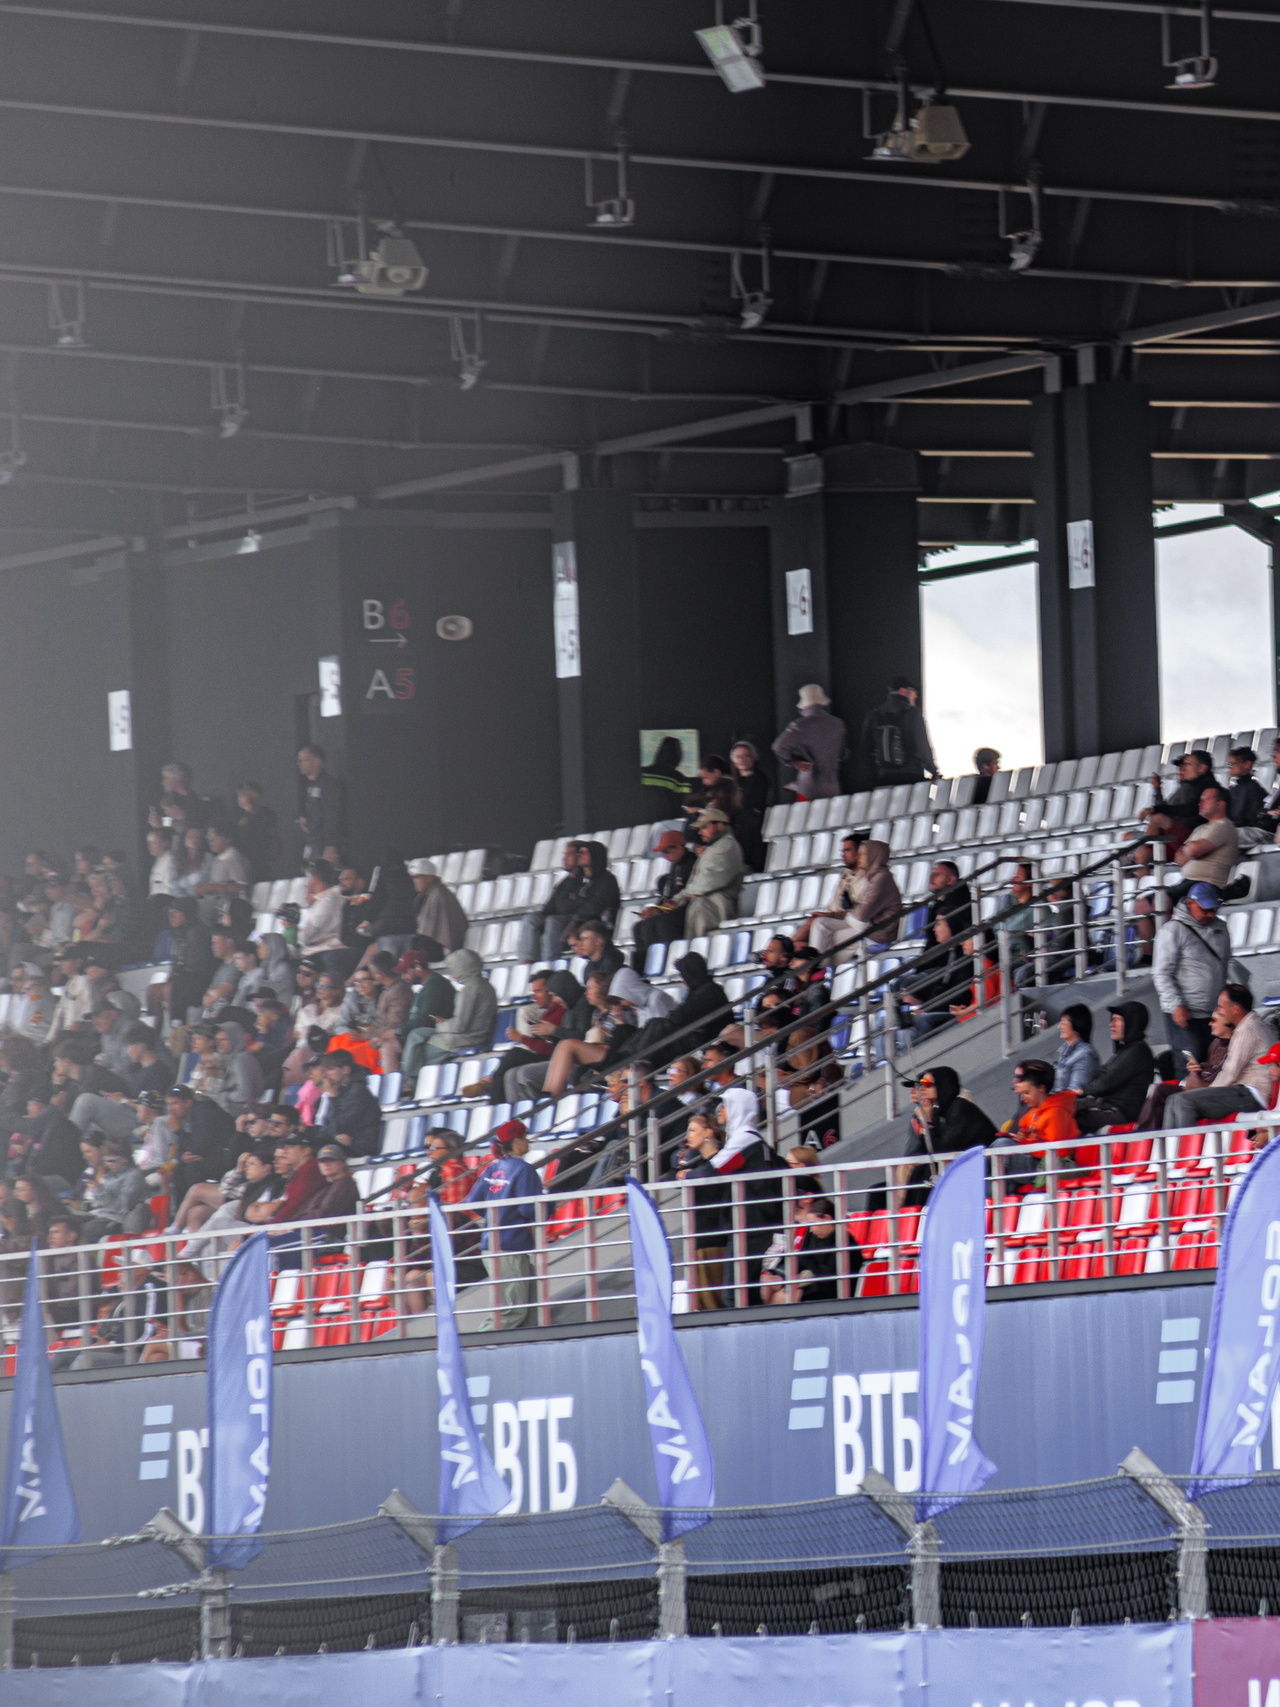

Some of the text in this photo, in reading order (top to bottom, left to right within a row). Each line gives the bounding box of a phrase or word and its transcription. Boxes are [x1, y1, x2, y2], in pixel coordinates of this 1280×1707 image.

[363, 600, 411, 630] B6
[366, 669, 415, 699] A5
[947, 1239, 974, 1465] MAJOR
[493, 1397, 578, 1515] ВТБ
[832, 1371, 921, 1495] ВТБ
